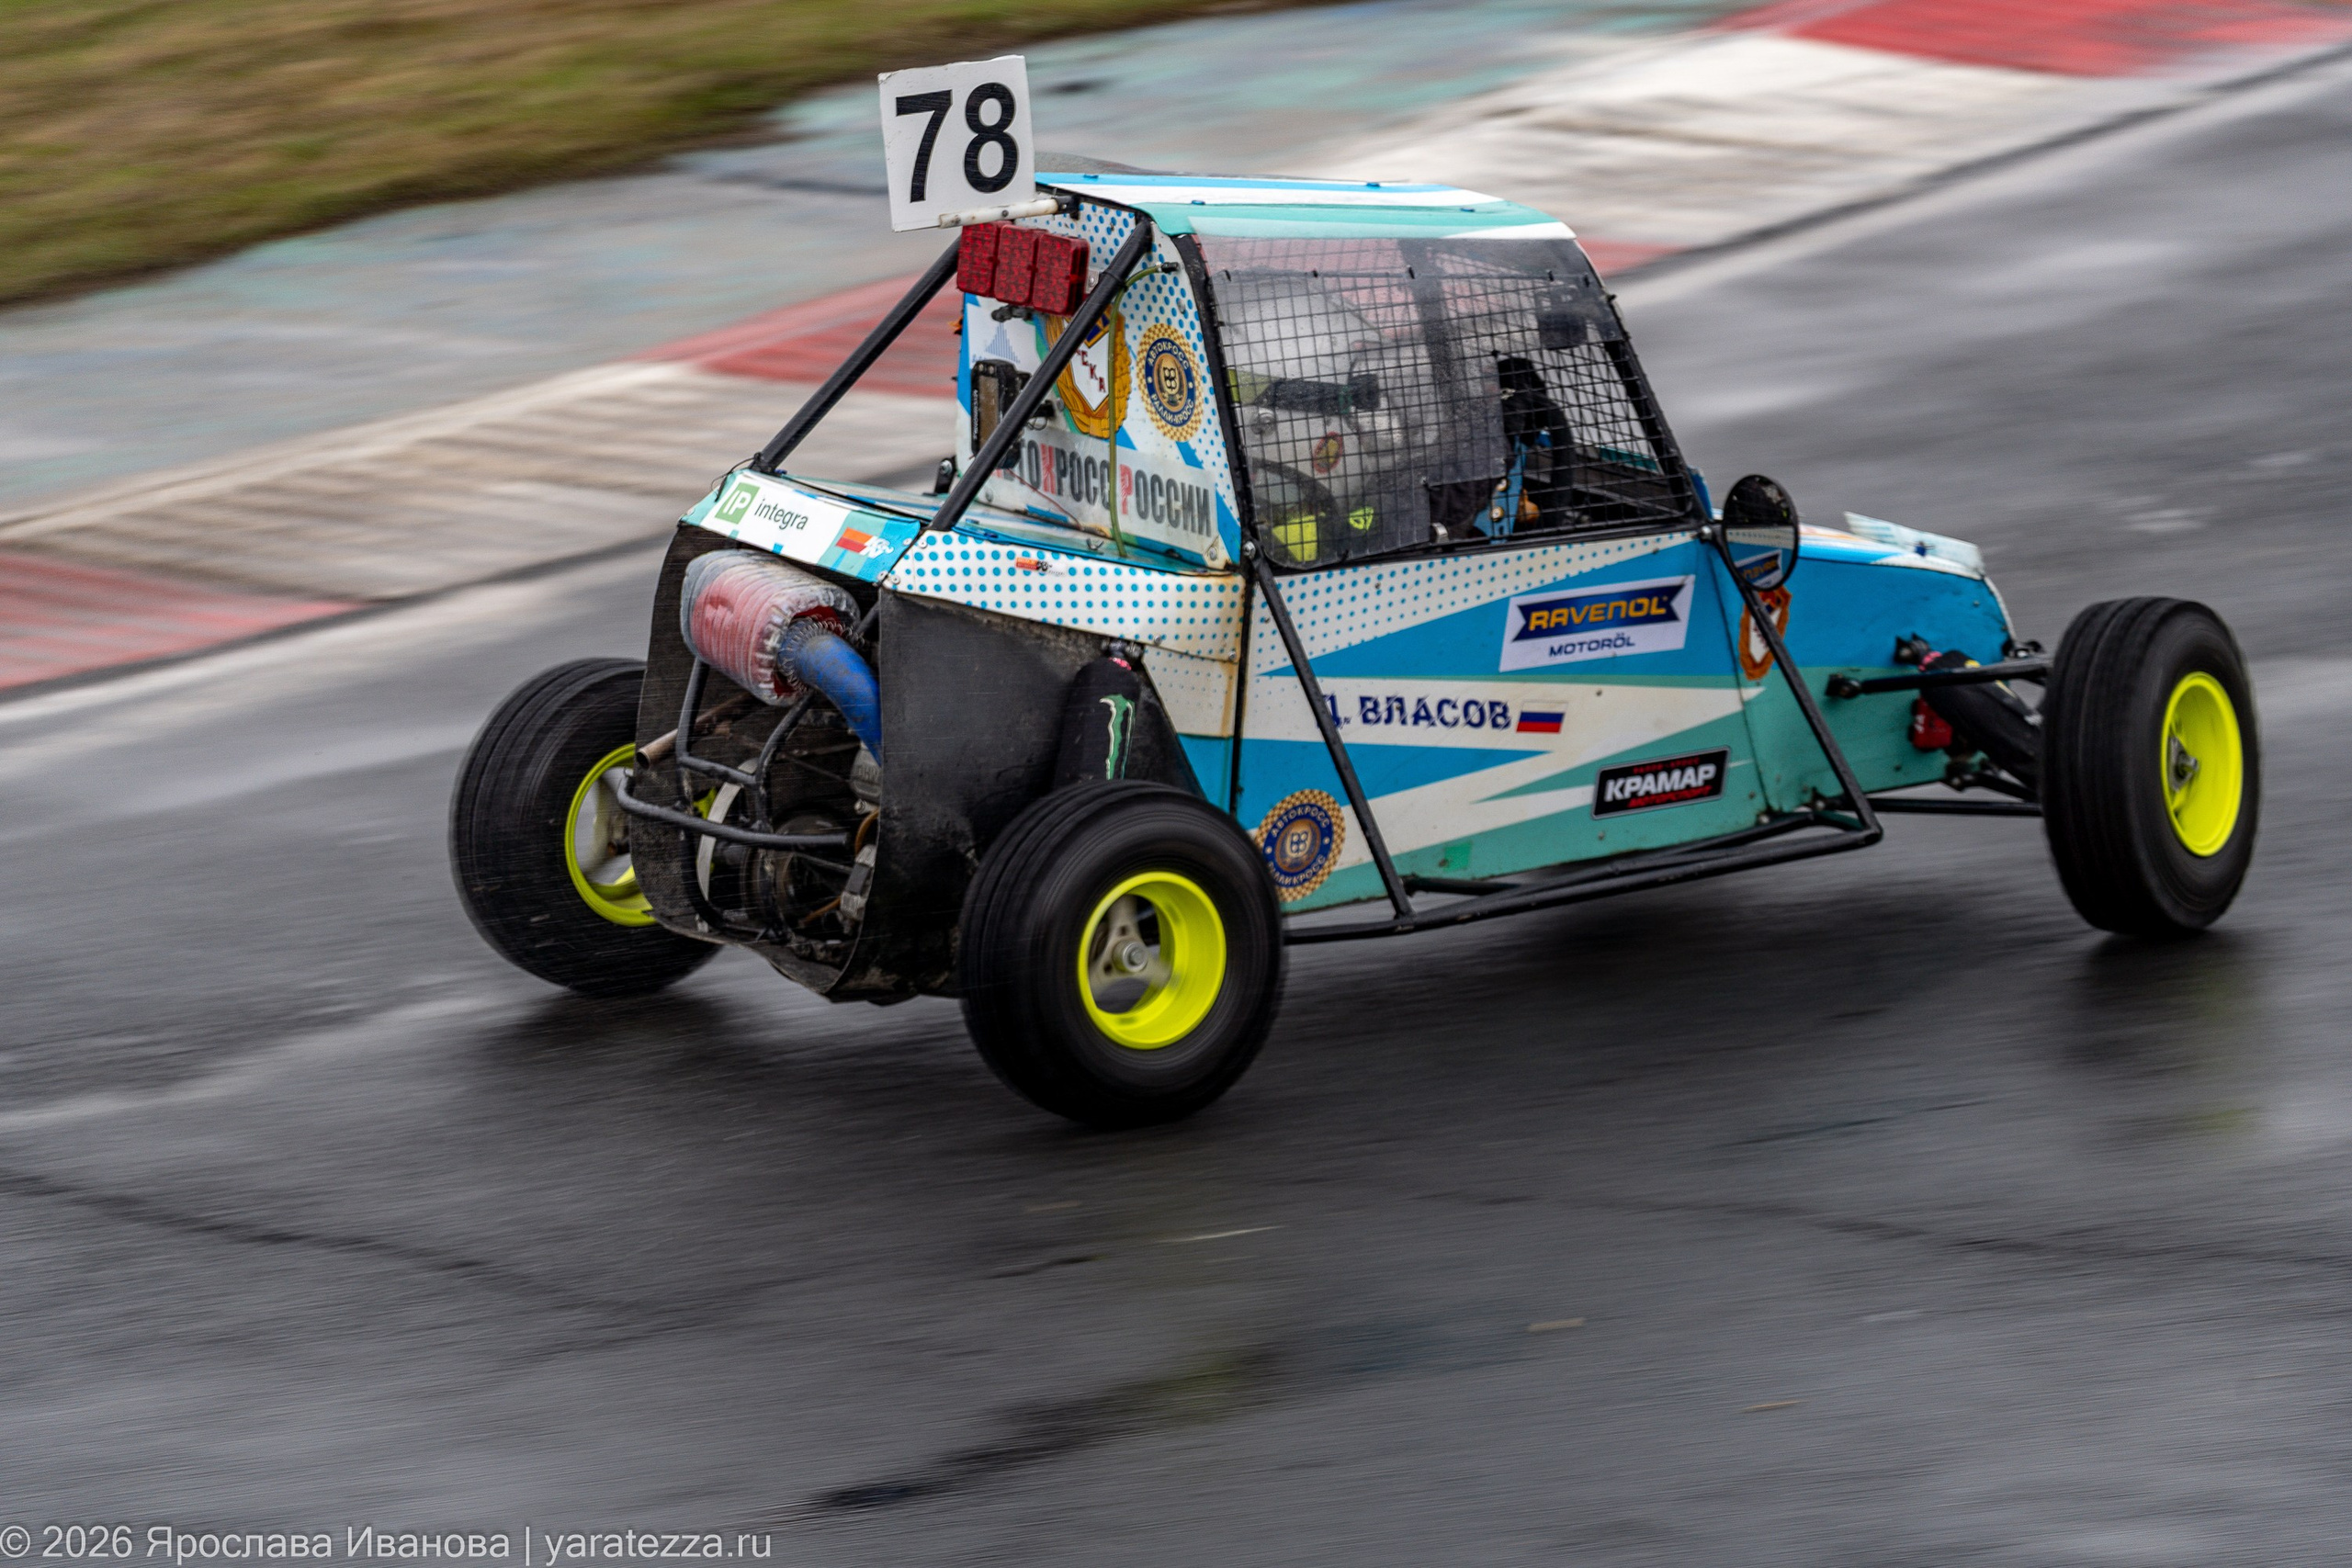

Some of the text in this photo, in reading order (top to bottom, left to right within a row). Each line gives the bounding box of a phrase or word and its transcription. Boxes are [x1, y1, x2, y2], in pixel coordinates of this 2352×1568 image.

[895, 82, 1019, 204] 78
[1076, 348, 1106, 393] СКА
[1147, 341, 1190, 370] АВТОКРОСС
[990, 437, 1212, 537] ТОКРОСС РОССИИ
[722, 490, 809, 530] IP integra
[1548, 632, 1635, 658] MOTORÖL
[1359, 694, 1511, 730] ВЛАСОВ
[1604, 763, 1716, 802] КРАМАР
[1272, 805, 1331, 838] АВТОКРОСС
